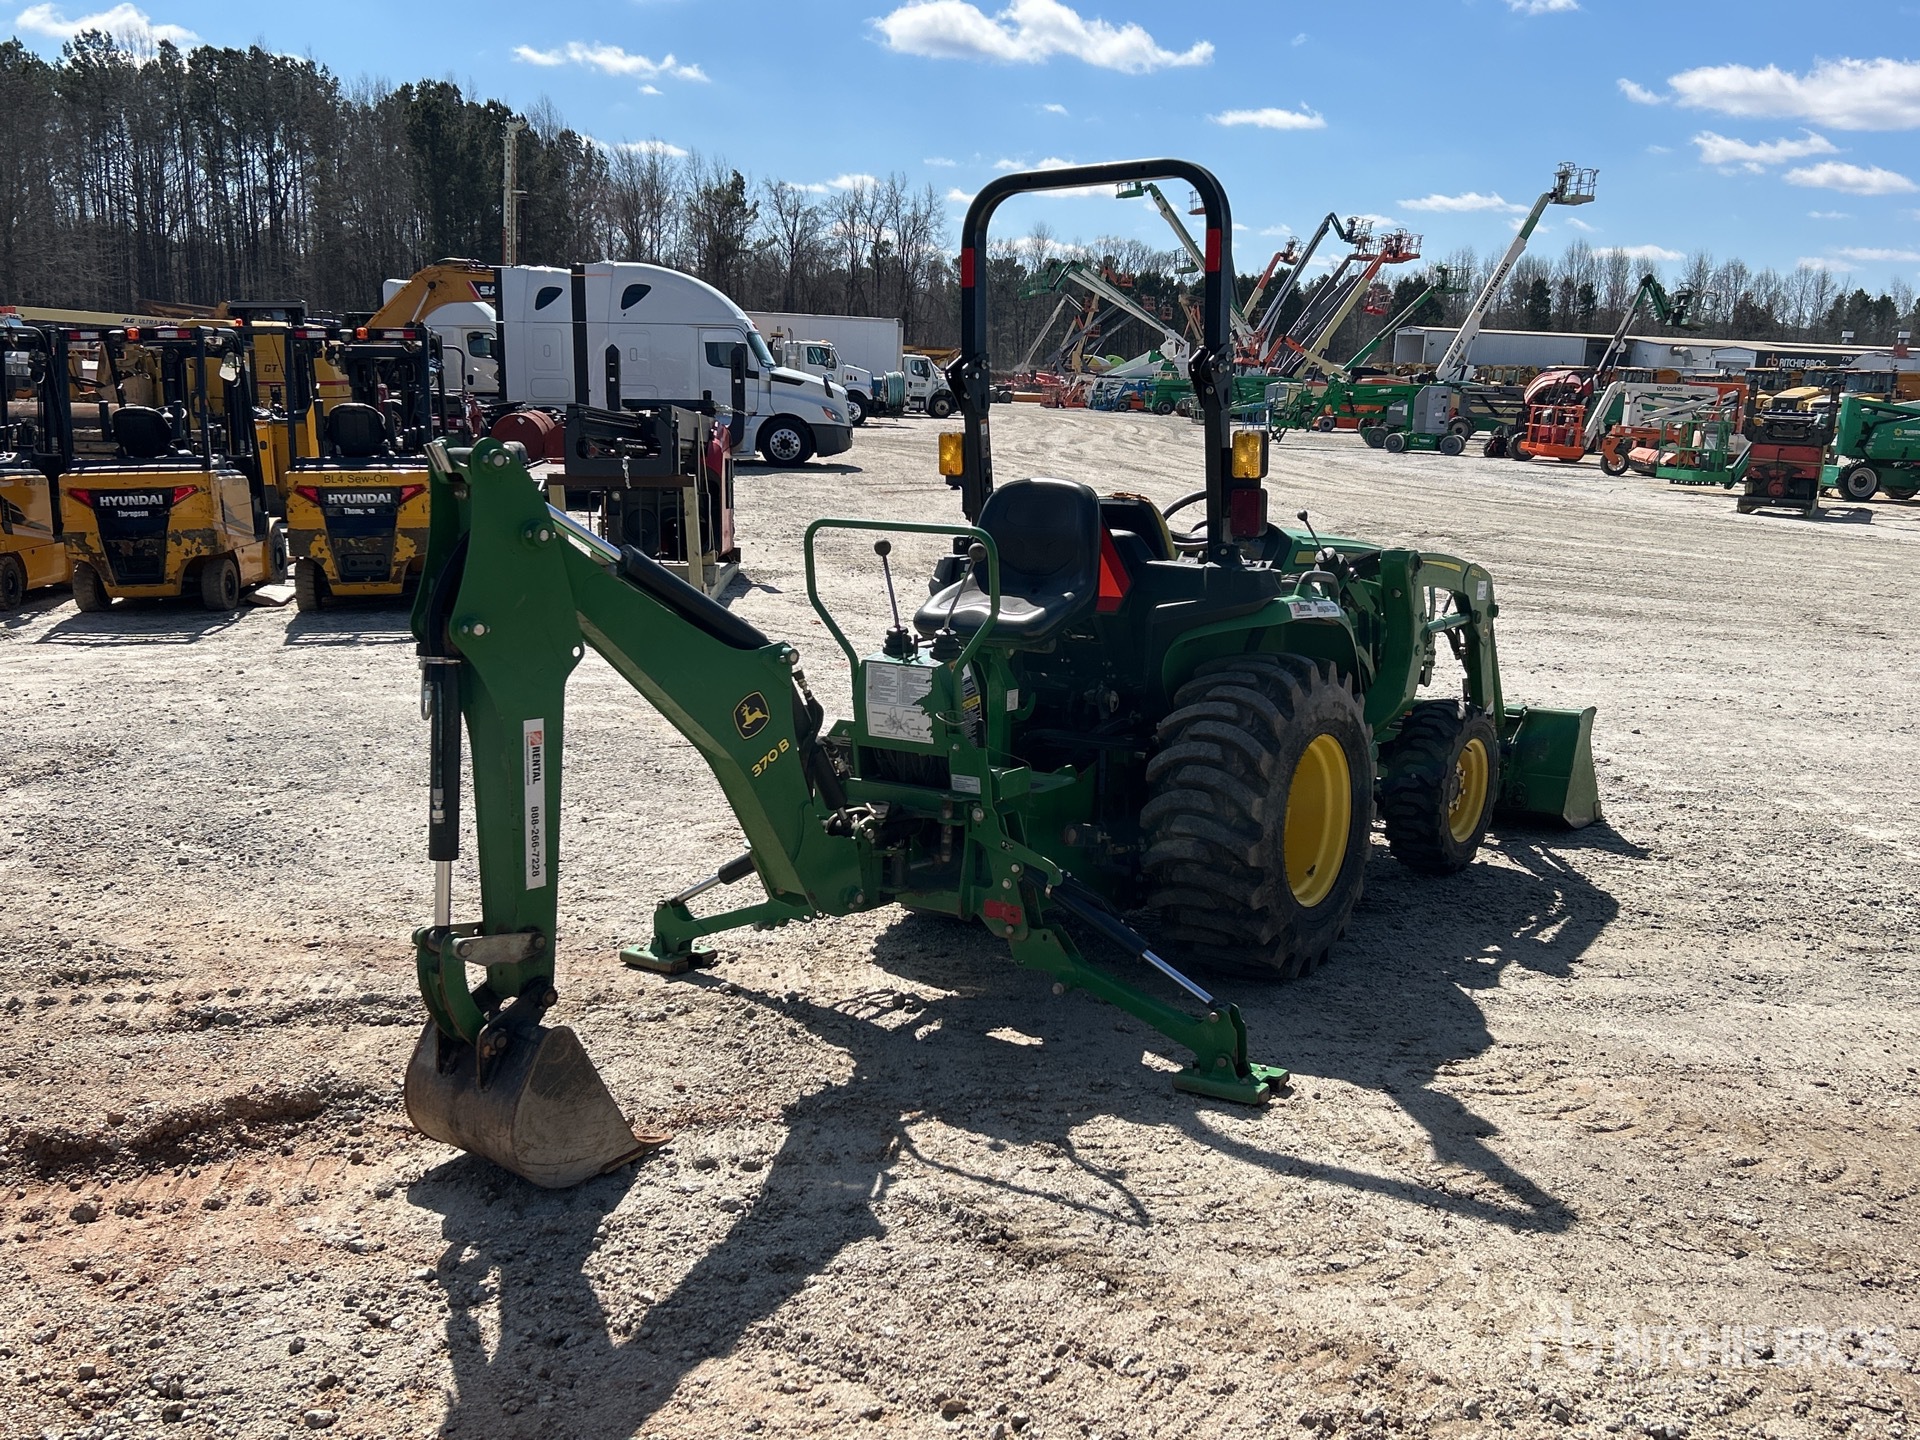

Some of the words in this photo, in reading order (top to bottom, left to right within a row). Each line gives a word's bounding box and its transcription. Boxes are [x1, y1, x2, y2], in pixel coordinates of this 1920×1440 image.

[1477, 287, 1496, 314] SUNBELT
[1492, 262, 1511, 288] RENTALS
[138, 318, 159, 326] ULTRA
[1291, 311, 1311, 337] SKYJACK
[1446, 353, 1456, 369] JLG
[1453, 337, 1465, 356] LIFT
[264, 364, 278, 373] GT
[1778, 358, 1805, 368] RITCHIE
[1662, 385, 1684, 393] snorkel
[323, 474, 345, 484] BL4
[346, 474, 390, 484] Sew-On
[99, 494, 164, 507] HYUNDAI
[327, 493, 392, 504] HYUNDAI
[751, 748, 779, 778] 370
[778, 738, 790, 754] B
[531, 745, 542, 785] RENTAL
[530, 805, 541, 878] 888-266-7228
